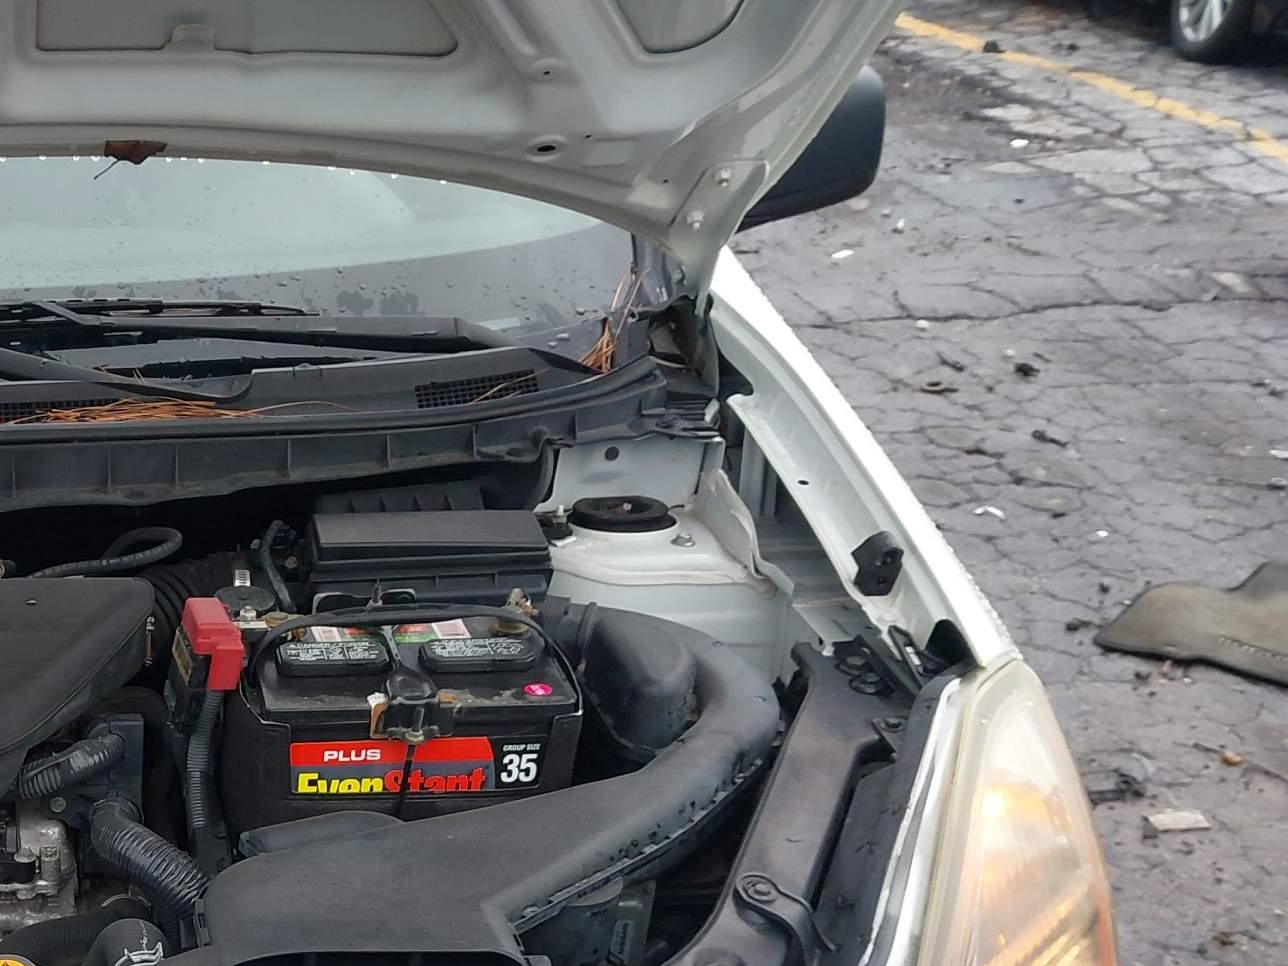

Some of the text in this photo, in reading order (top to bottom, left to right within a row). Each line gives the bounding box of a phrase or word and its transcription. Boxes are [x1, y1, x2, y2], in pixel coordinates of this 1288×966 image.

[502, 743, 542, 752] GROUP SIZE
[323, 748, 382, 762] PLUS
[500, 753, 539, 783] 35
